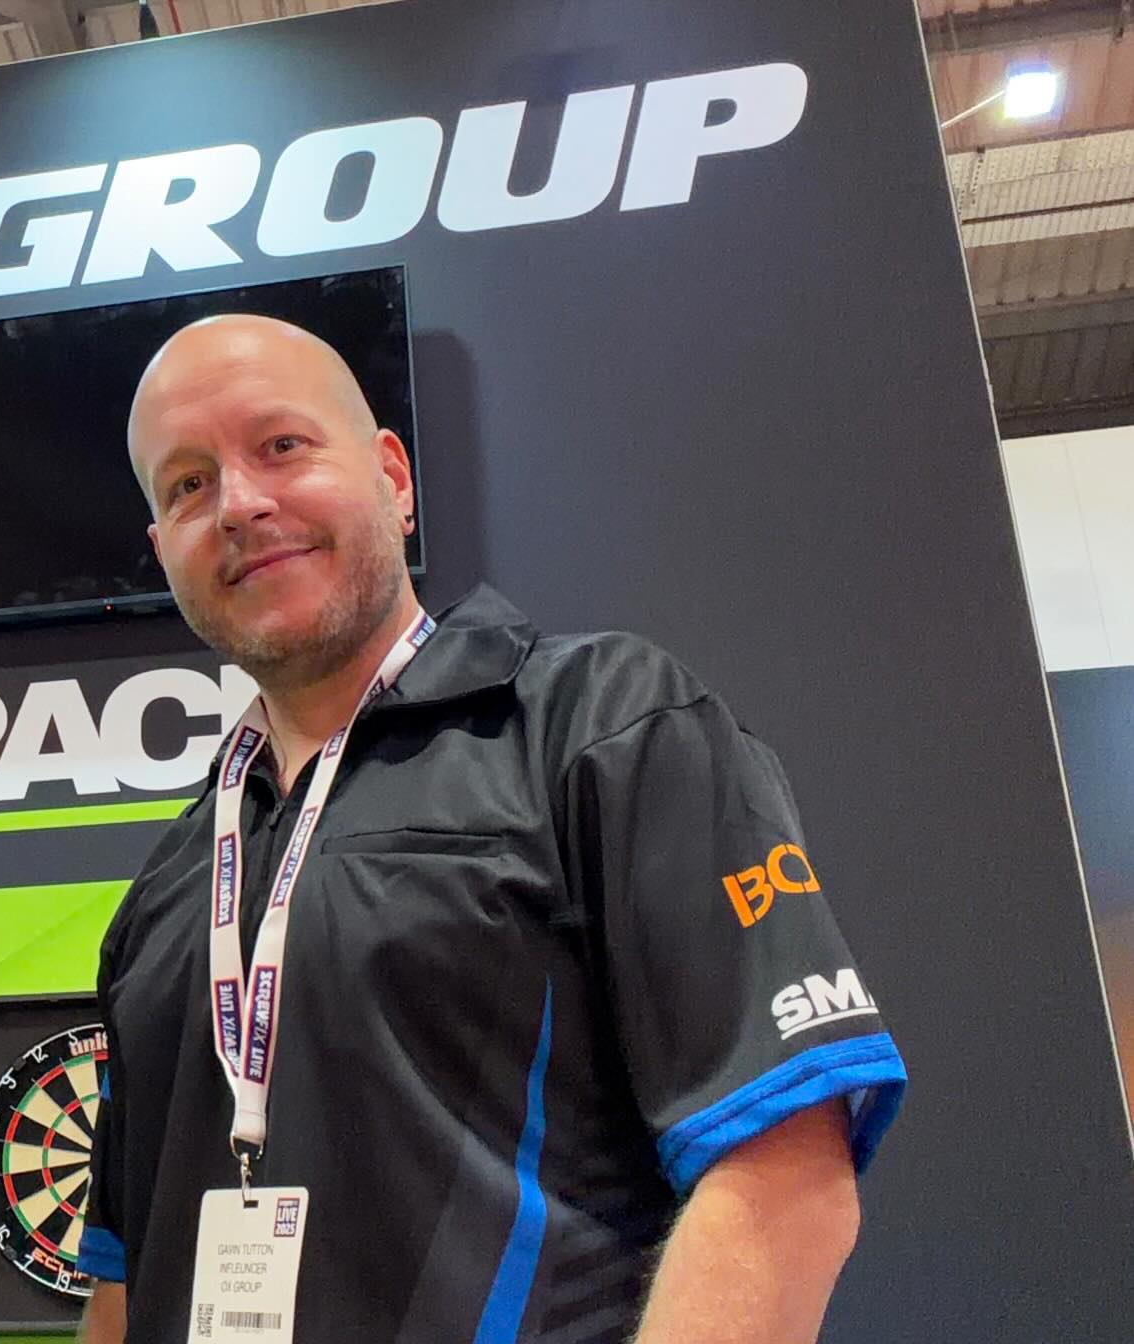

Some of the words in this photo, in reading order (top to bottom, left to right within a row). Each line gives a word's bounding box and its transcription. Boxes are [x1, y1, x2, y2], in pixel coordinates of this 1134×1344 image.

[221, 838, 233, 858] LIVE
[218, 983, 234, 1012] LIVE
[251, 970, 274, 1046] SCREWFIX
[771, 968, 876, 1031] SM
[249, 1047, 265, 1079] LIVE
[233, 1281, 263, 1293] GROUP
